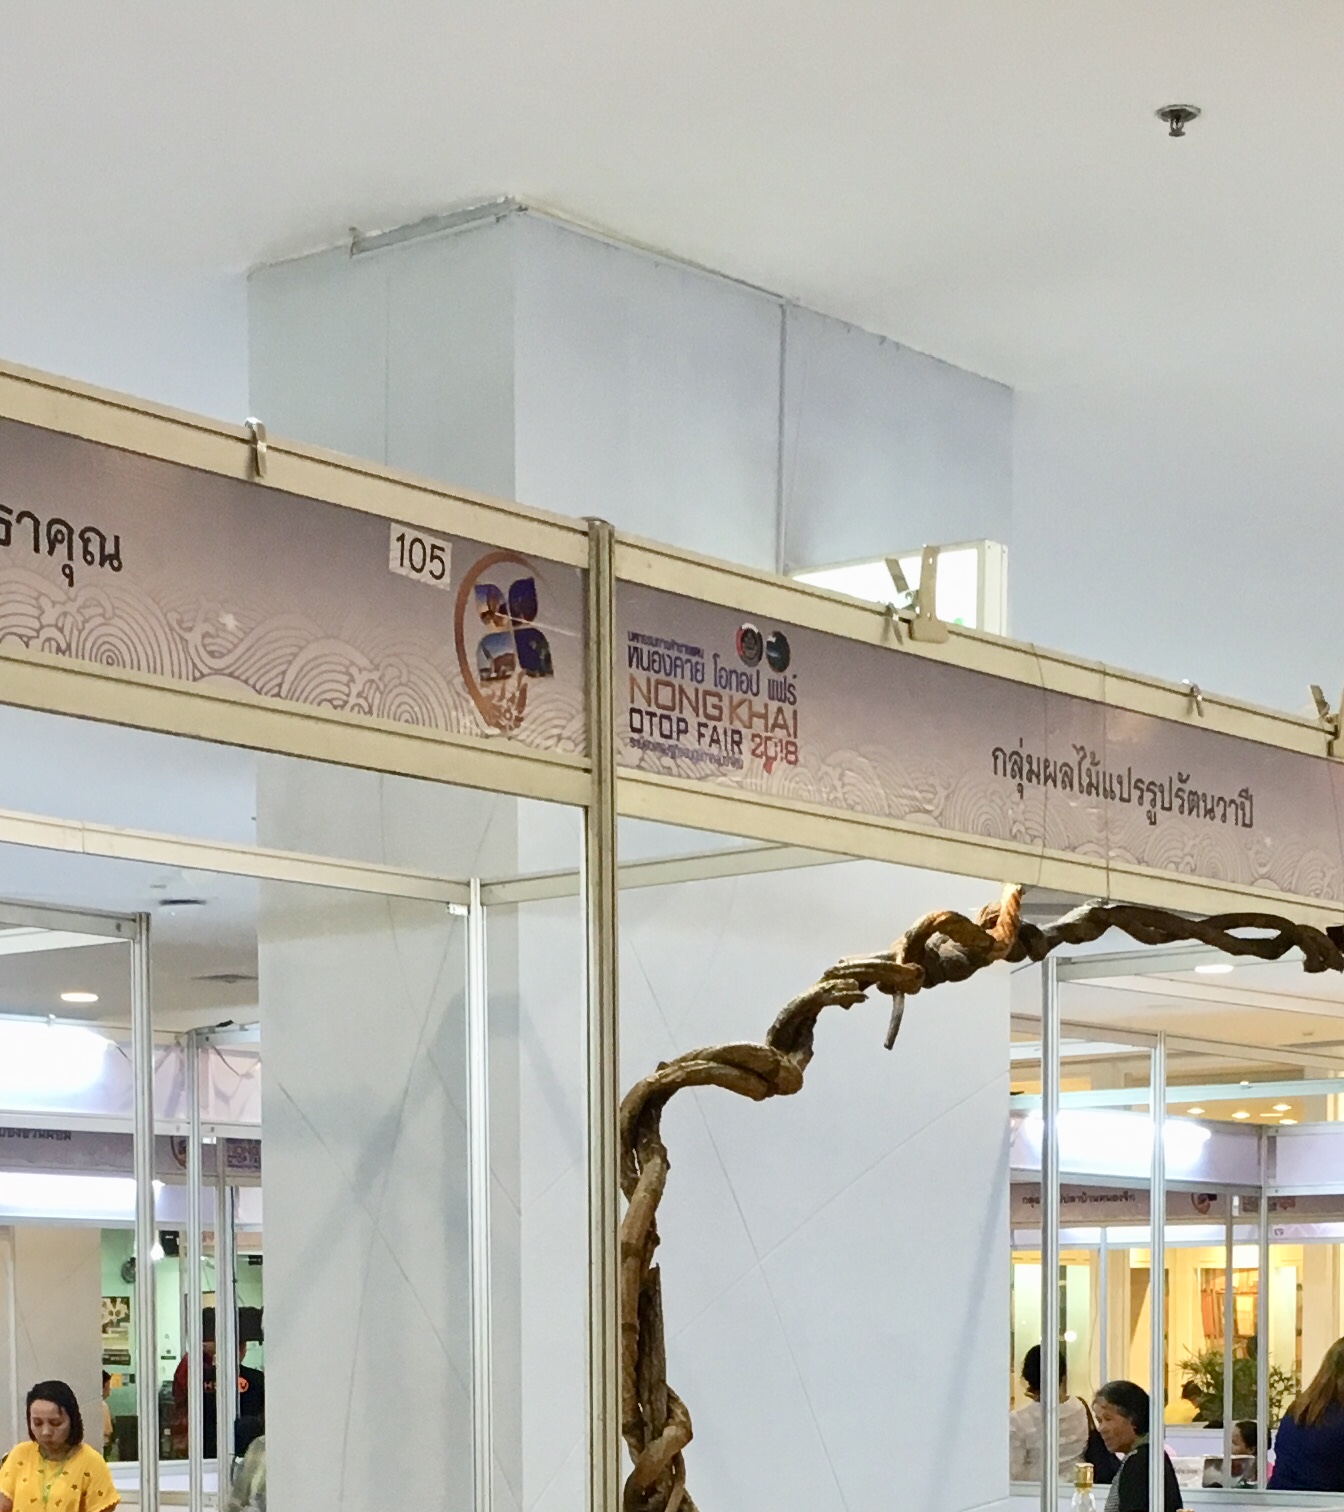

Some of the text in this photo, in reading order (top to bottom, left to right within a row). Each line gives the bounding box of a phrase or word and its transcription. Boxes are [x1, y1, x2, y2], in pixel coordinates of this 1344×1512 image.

[395, 532, 446, 581] 105
[627, 644, 706, 684] หนองคาย
[712, 653, 760, 697] โอทอป
[629, 707, 689, 742] OTOP
[697, 721, 743, 756] FAIR
[751, 733, 799, 766] 2018
[991, 736, 1255, 829] กลุ่มผลไม้แปรรูปรัตนวาปี
